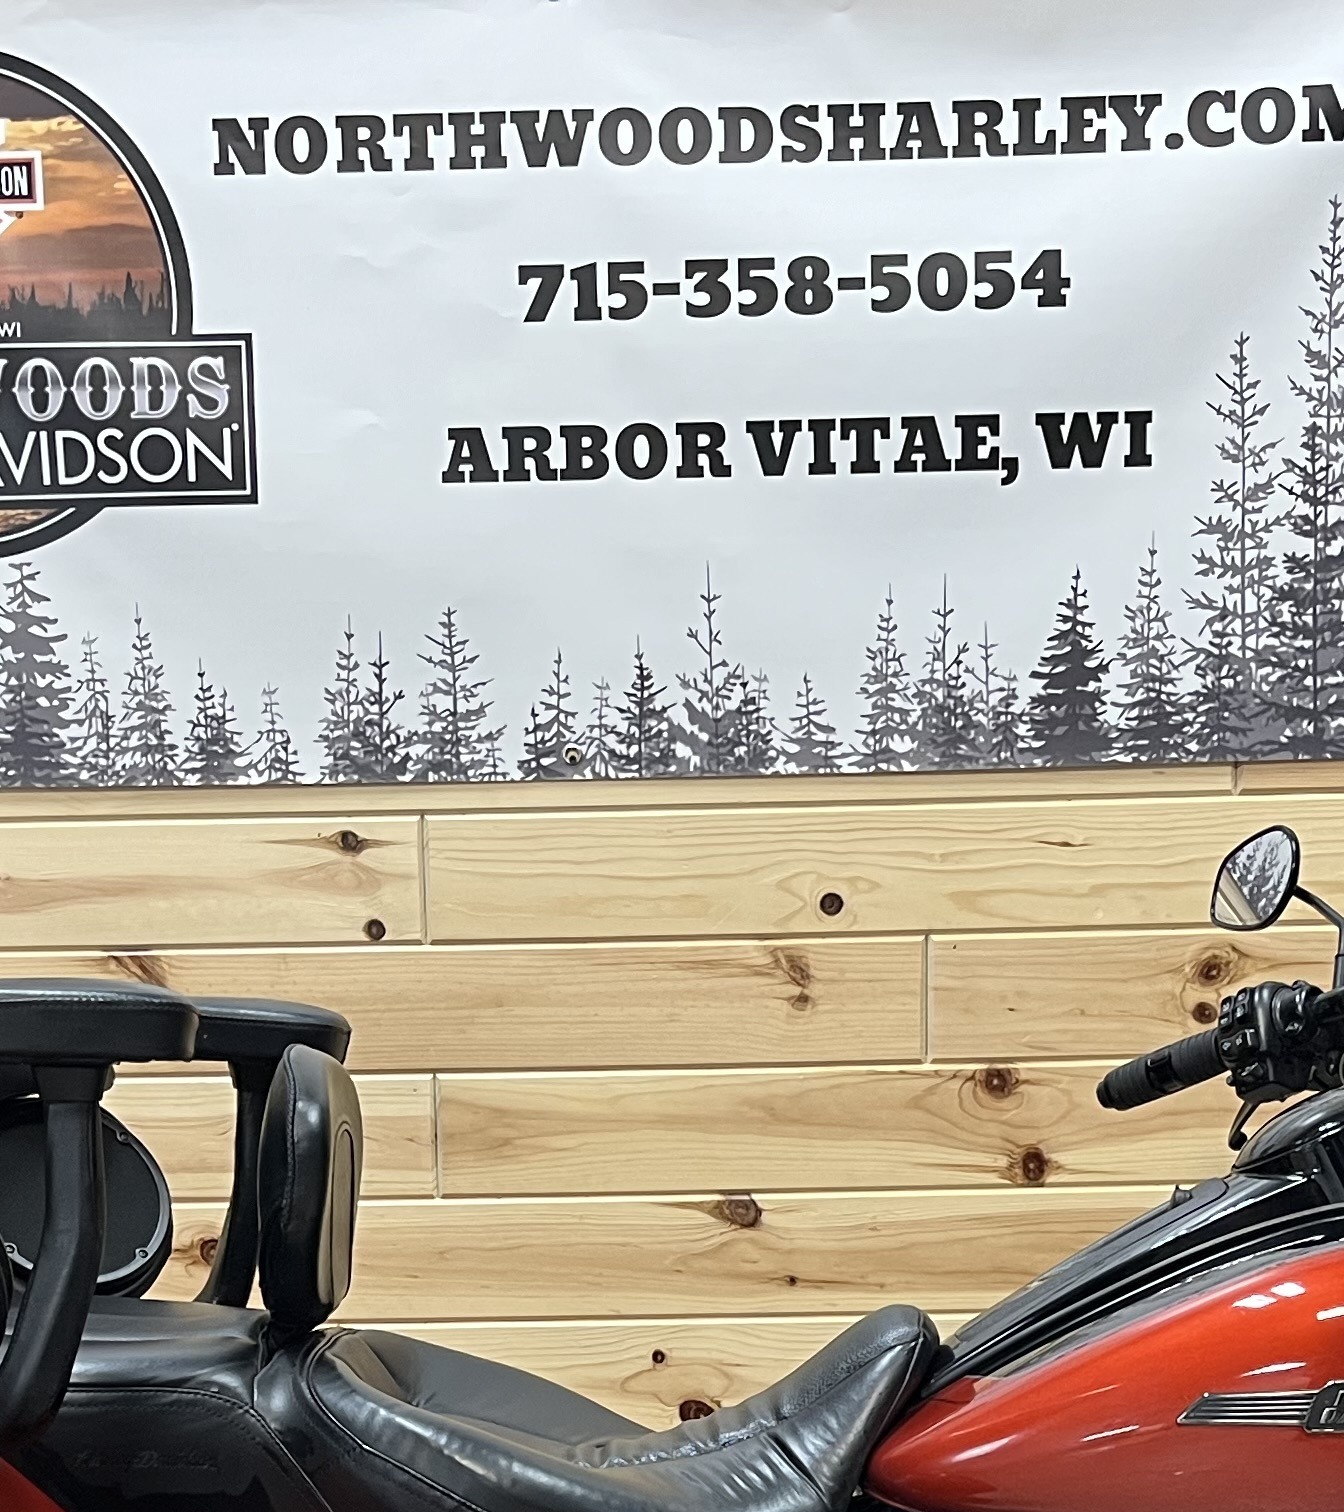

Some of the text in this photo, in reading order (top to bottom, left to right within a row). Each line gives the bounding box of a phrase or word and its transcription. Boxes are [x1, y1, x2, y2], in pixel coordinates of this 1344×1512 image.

[517, 248, 1071, 323] 715-358-5054
[442, 410, 1154, 487] ARBOR VITAE, WI
